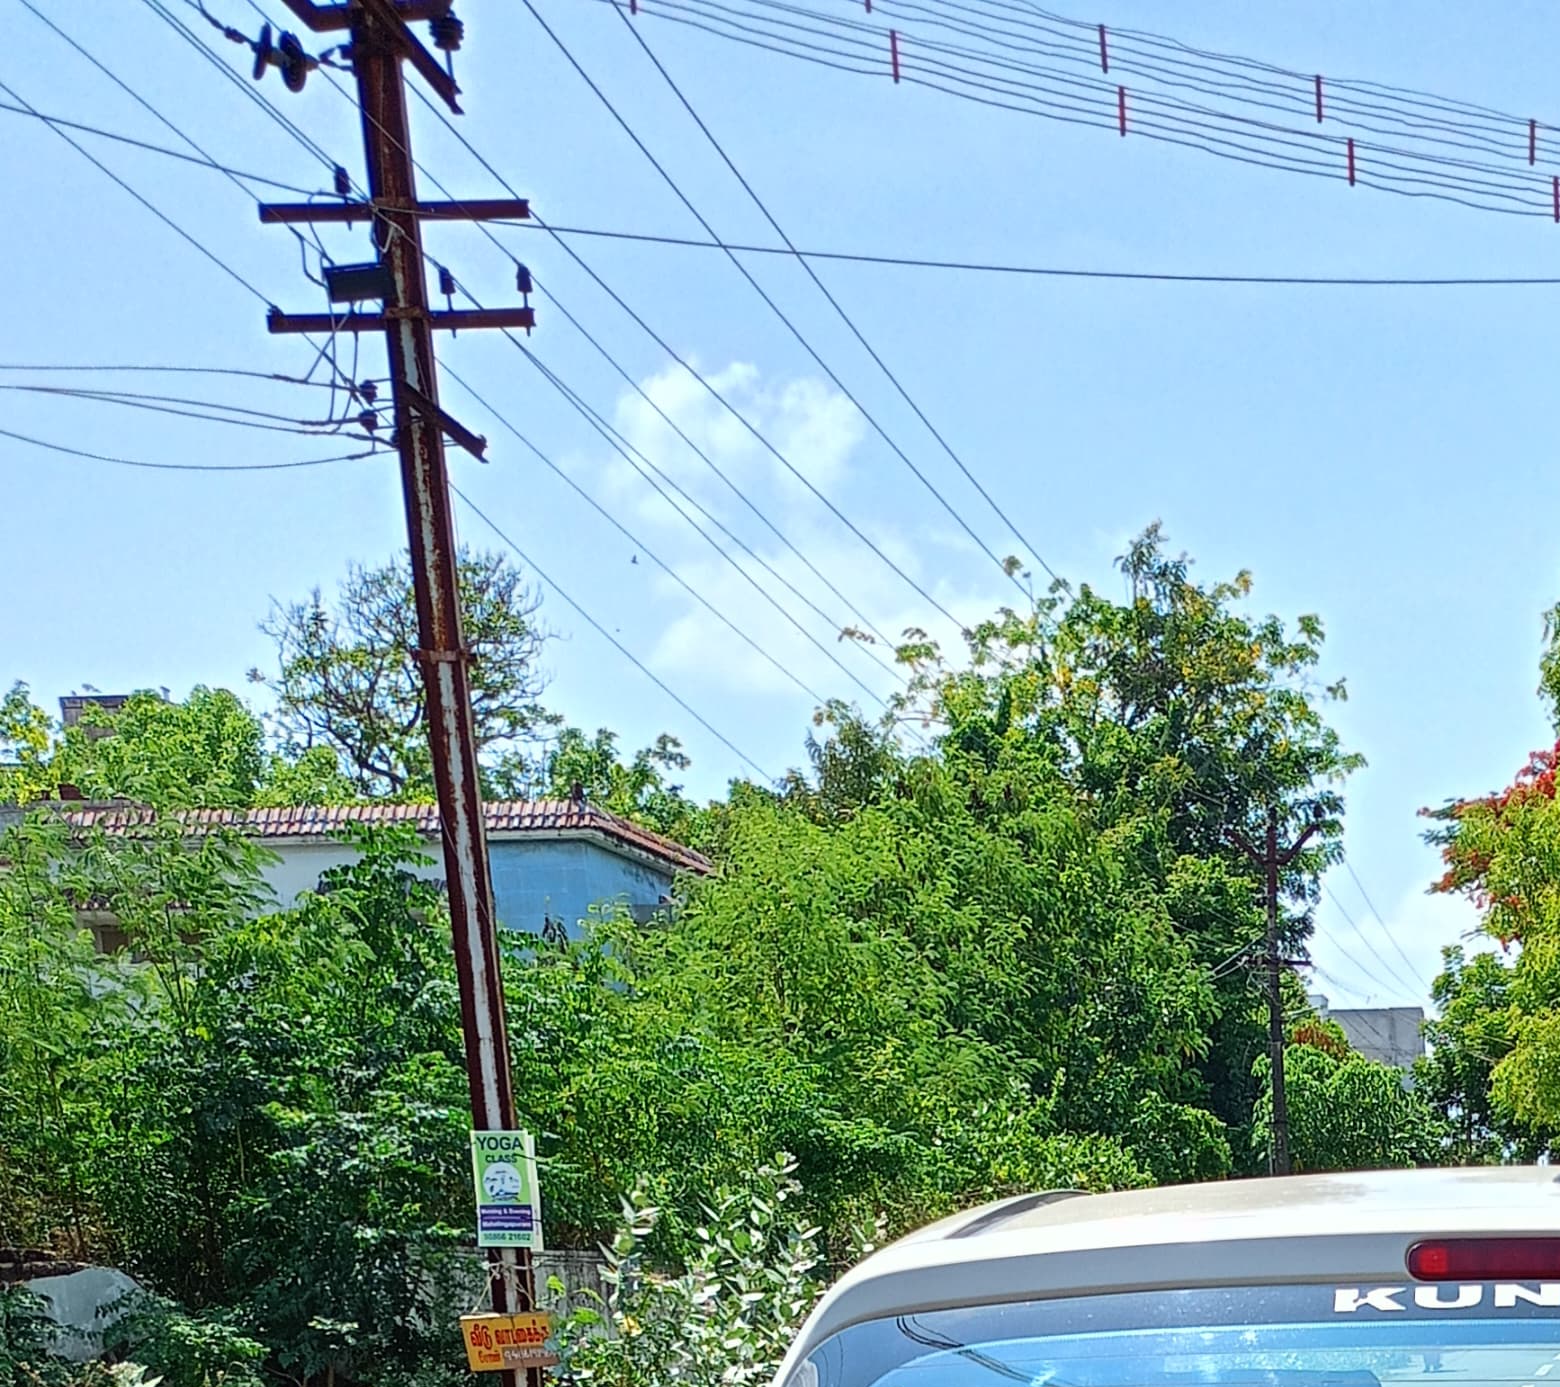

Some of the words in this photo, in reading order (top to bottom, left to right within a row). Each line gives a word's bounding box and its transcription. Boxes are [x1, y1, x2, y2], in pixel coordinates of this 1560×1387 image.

[475, 1136, 525, 1152] YOGA
[485, 1153, 518, 1164] CLASS
[471, 1322, 493, 1350] வீடு
